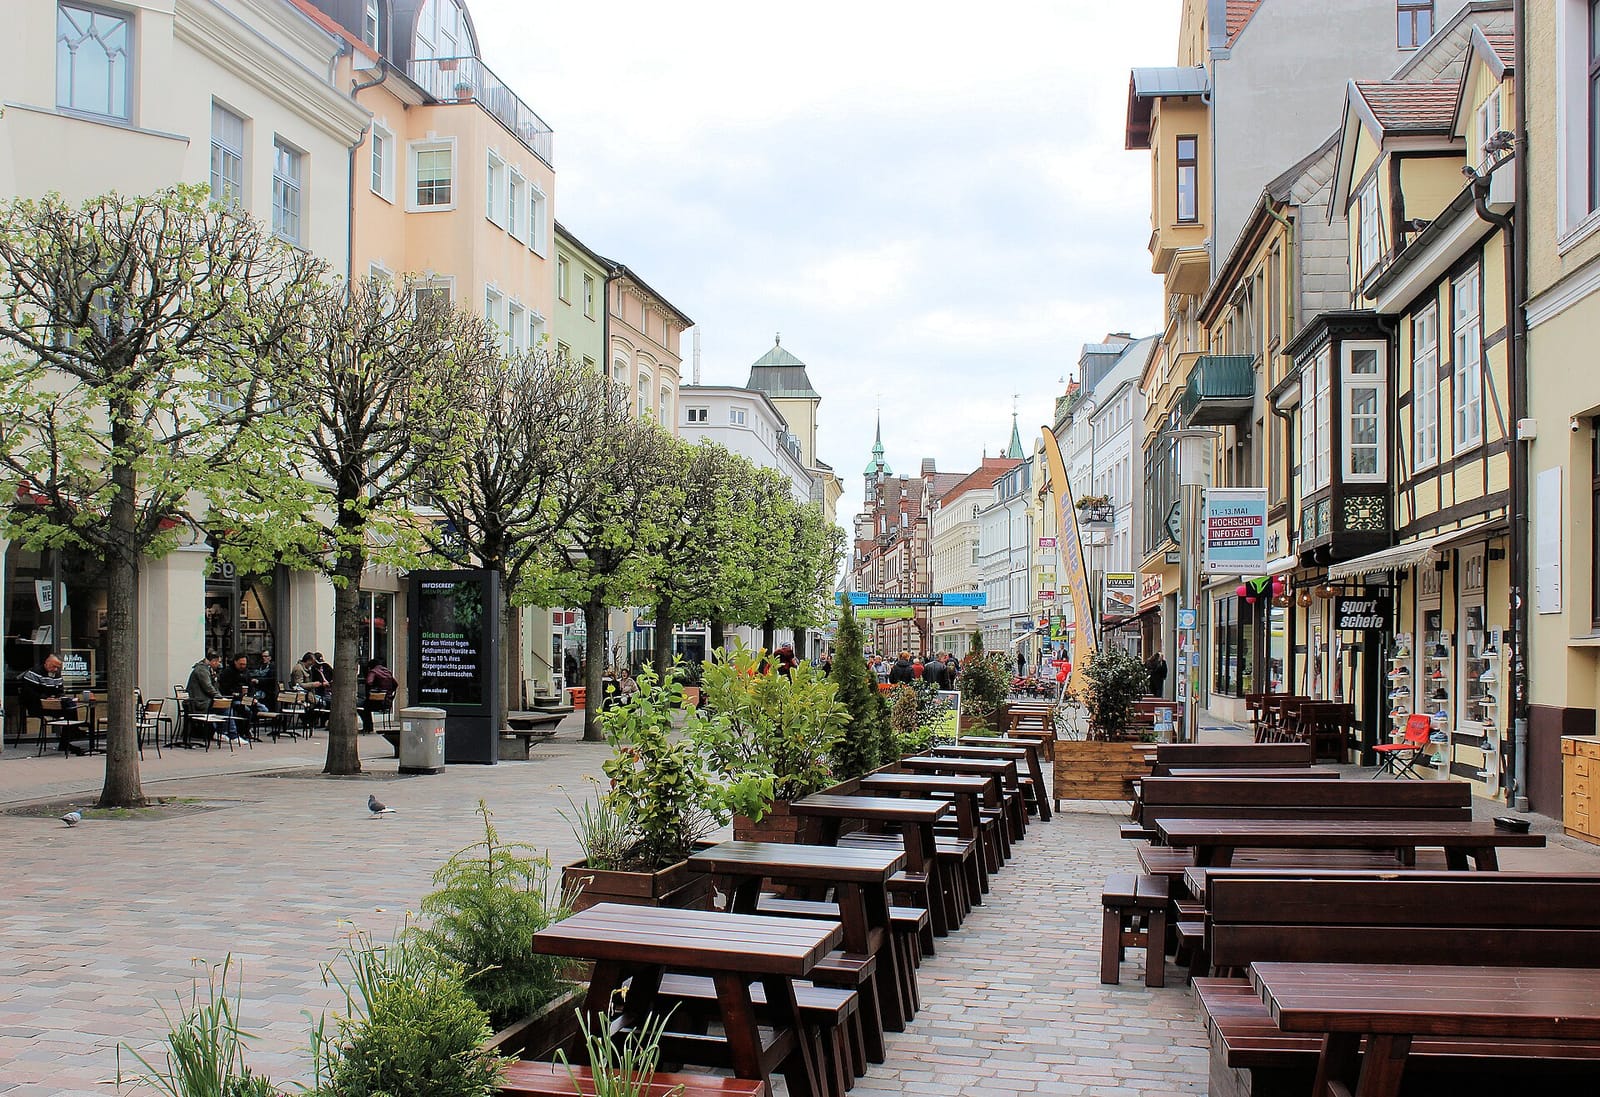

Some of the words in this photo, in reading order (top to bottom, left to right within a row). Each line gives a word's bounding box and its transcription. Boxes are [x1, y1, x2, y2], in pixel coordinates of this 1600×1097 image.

[1212, 517, 1260, 527] HOCHSCHUL-
[1212, 528, 1250, 538] INFOTAGE
[1340, 599, 1378, 614] sport
[1340, 614, 1384, 628] schefe
